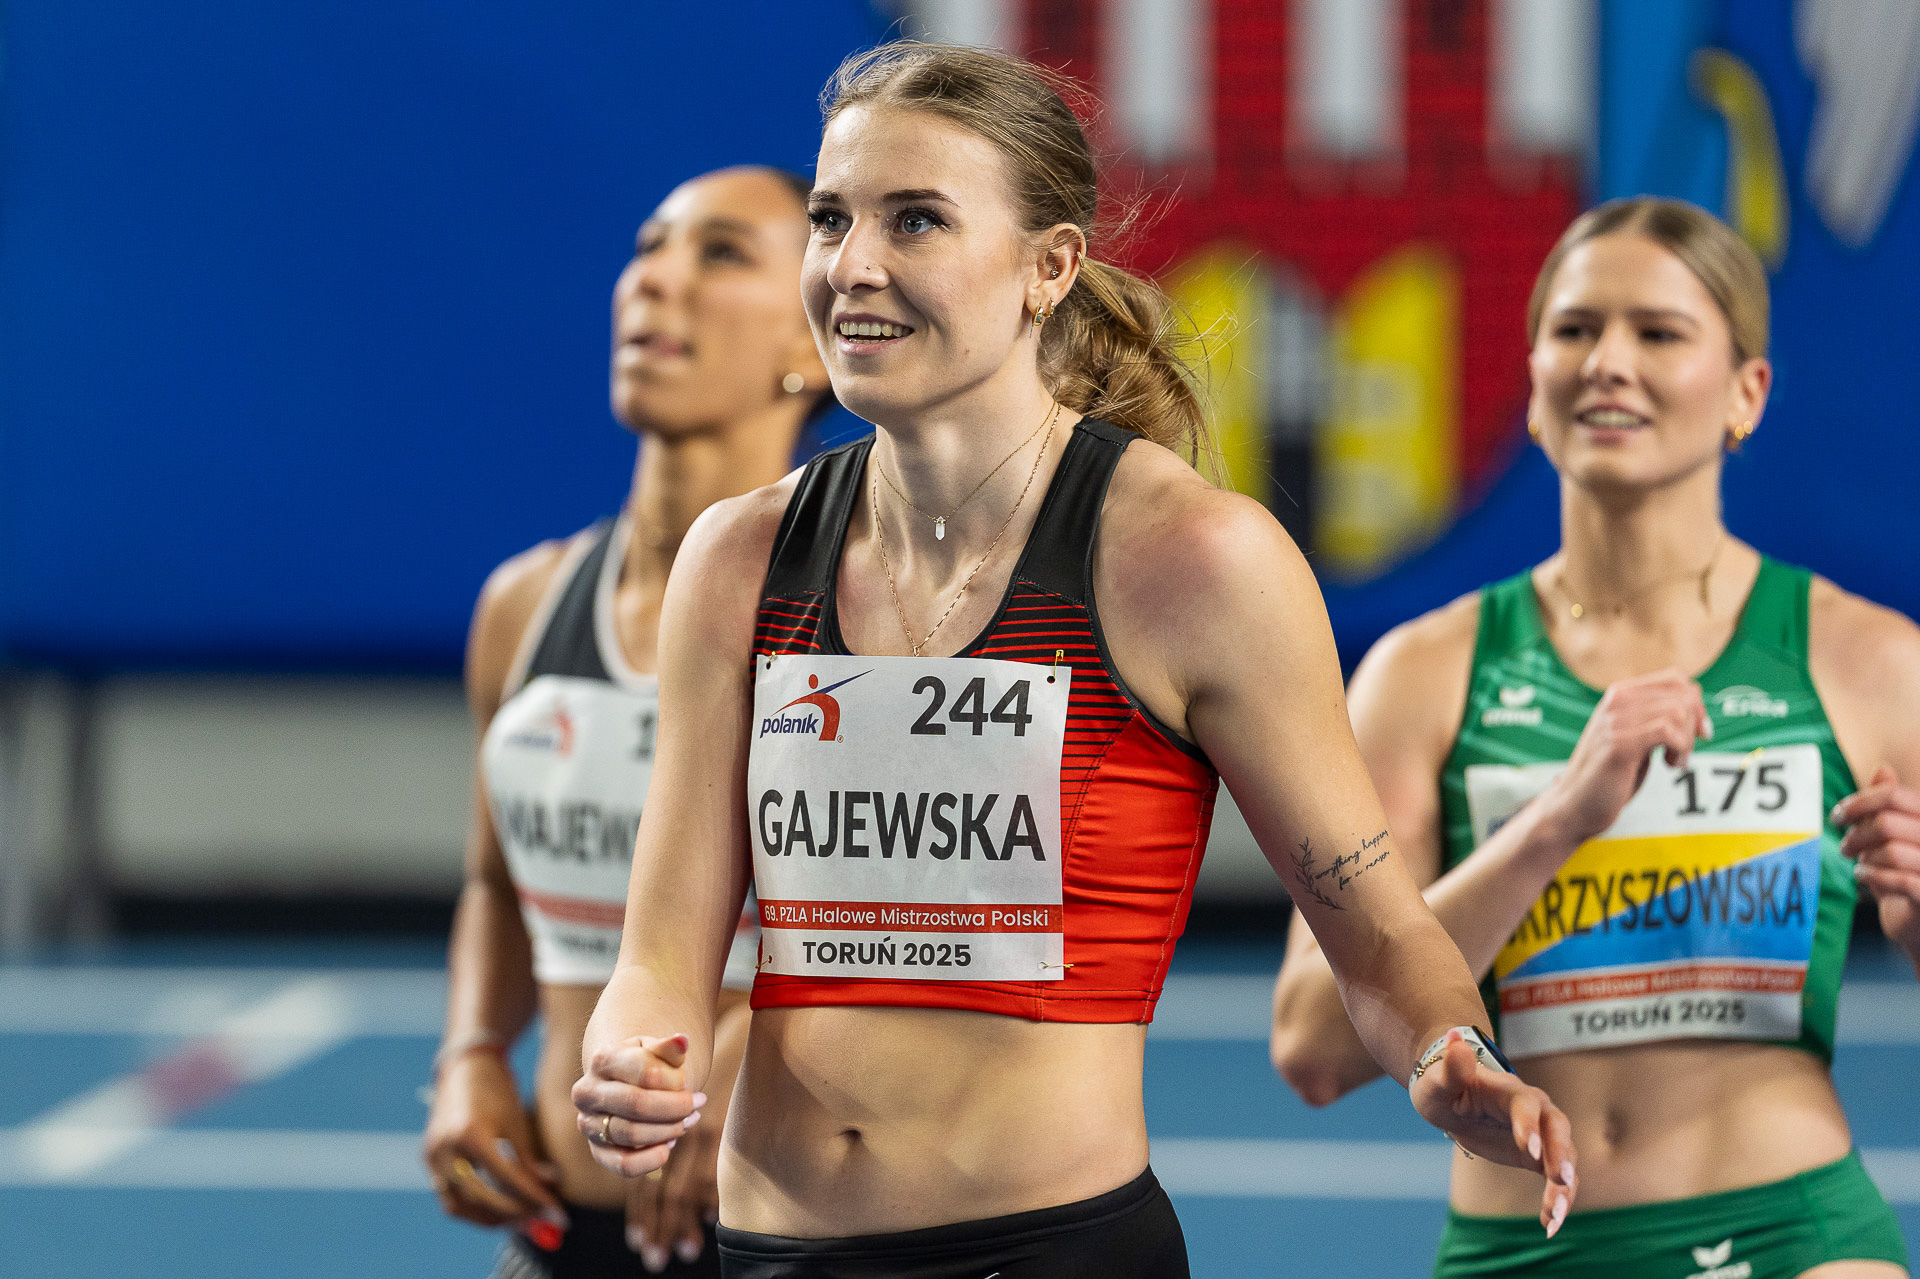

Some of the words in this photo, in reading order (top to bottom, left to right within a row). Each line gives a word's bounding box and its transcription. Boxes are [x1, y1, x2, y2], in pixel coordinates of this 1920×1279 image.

[759, 713, 820, 739] polanik
[910, 675, 1032, 737] 244
[1674, 761, 1789, 816] 175
[758, 789, 1047, 862] GAJEWSKA
[764, 905, 779, 922] 69.
[779, 906, 808, 923] PZLA
[812, 907, 876, 924] Halowe
[881, 908, 985, 927] Mistrzostwa
[991, 909, 1049, 927] Polski
[1508, 864, 1807, 945] KRZYSZOWSKA
[802, 935, 896, 966] TORUŃ
[903, 943, 972, 967] 2025
[1571, 997, 1670, 1034] TORUŃ
[1681, 997, 1747, 1024] 2025
